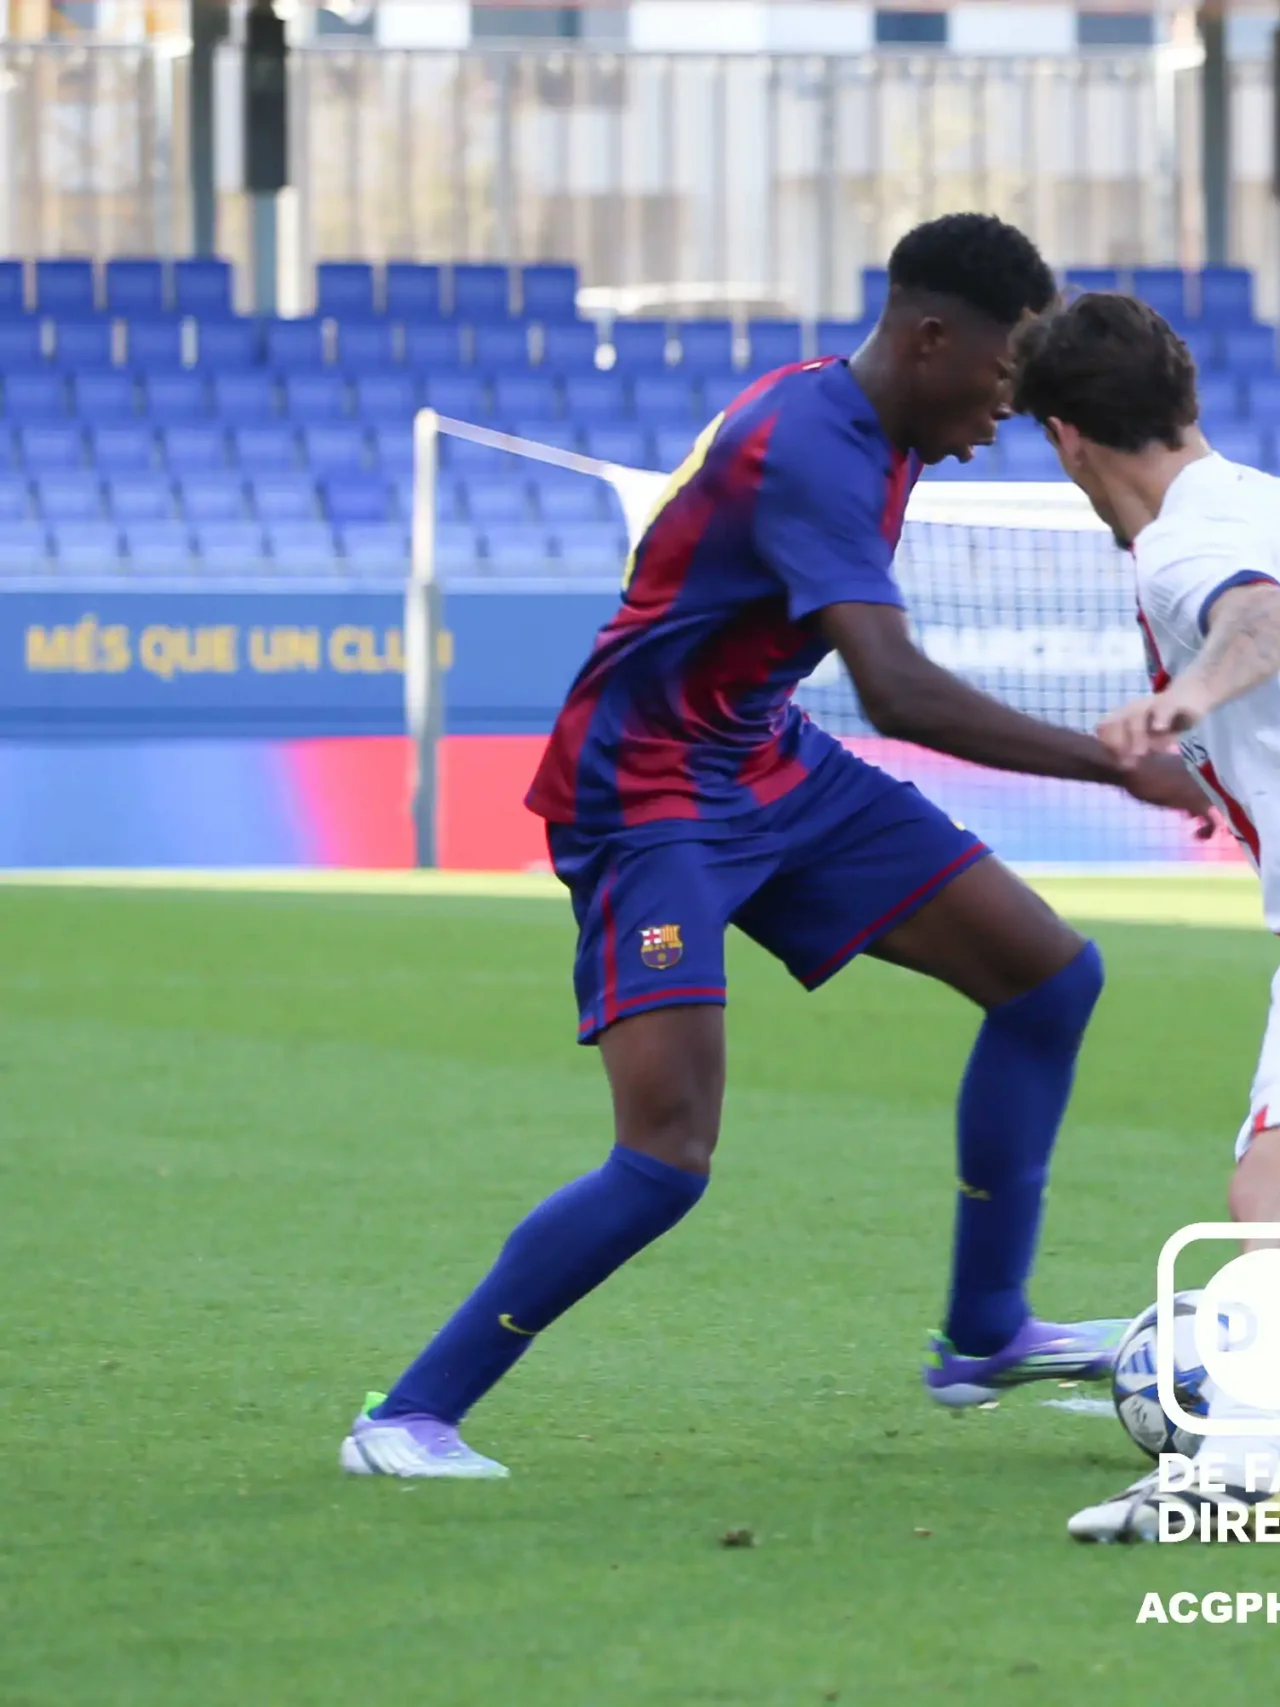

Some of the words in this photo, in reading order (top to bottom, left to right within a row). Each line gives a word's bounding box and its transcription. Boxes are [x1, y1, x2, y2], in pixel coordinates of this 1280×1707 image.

[27, 613, 131, 672] MÉS
[140, 626, 238, 680] QUE
[249, 626, 320, 673] UN
